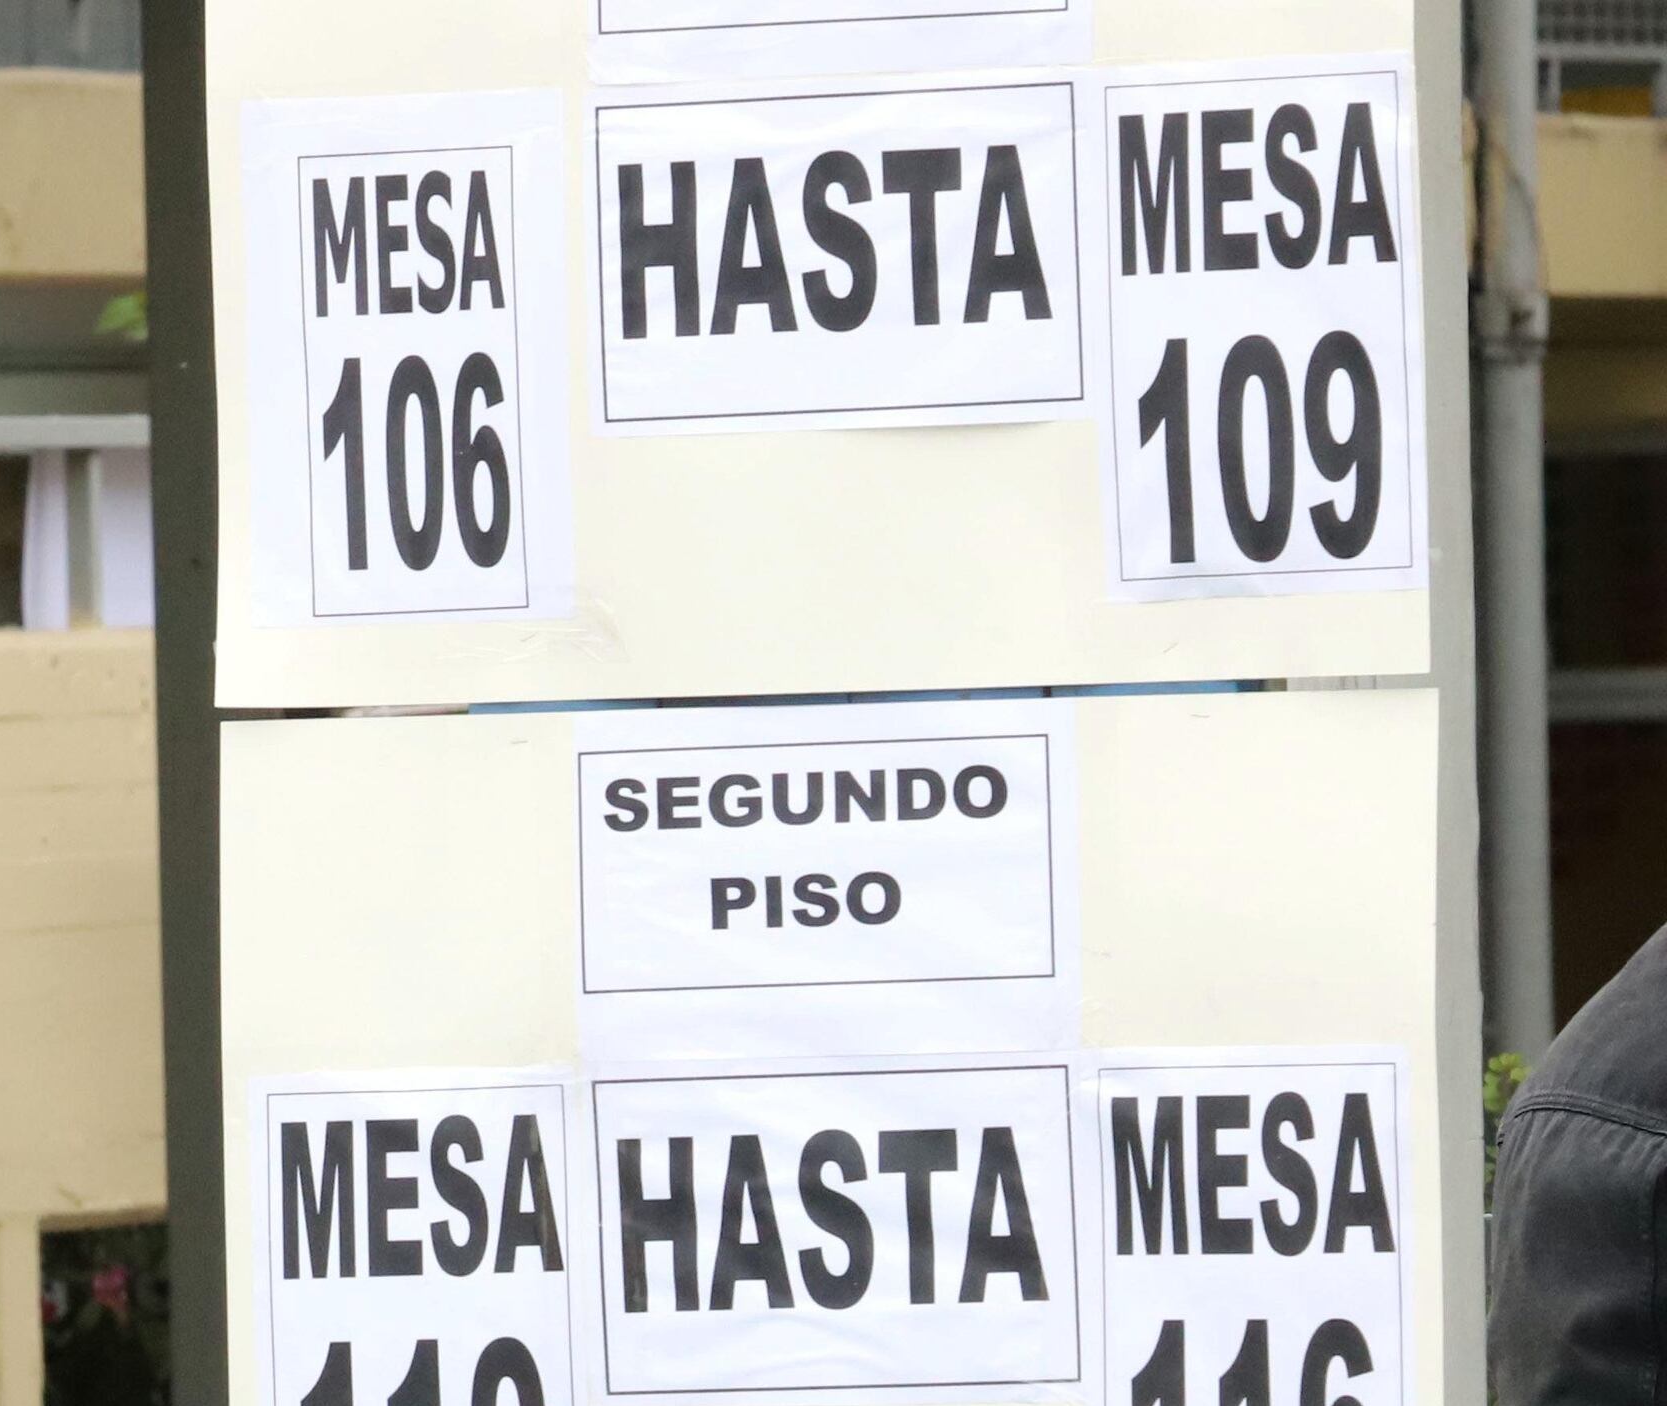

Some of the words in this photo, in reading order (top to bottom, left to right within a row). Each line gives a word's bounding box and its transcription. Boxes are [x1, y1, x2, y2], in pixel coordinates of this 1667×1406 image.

[313, 170, 505, 317] MESA
[618, 144, 1052, 339] HASTA
[1119, 102, 1398, 276] MESA
[323, 352, 511, 571] 106
[1138, 330, 1382, 564] 109
[603, 765, 1009, 833] SEGUNDO
[709, 871, 903, 930] PISO
[281, 1114, 565, 1280] MESA
[617, 1126, 1049, 1313] HASTA
[1111, 1092, 1396, 1257] MESA
